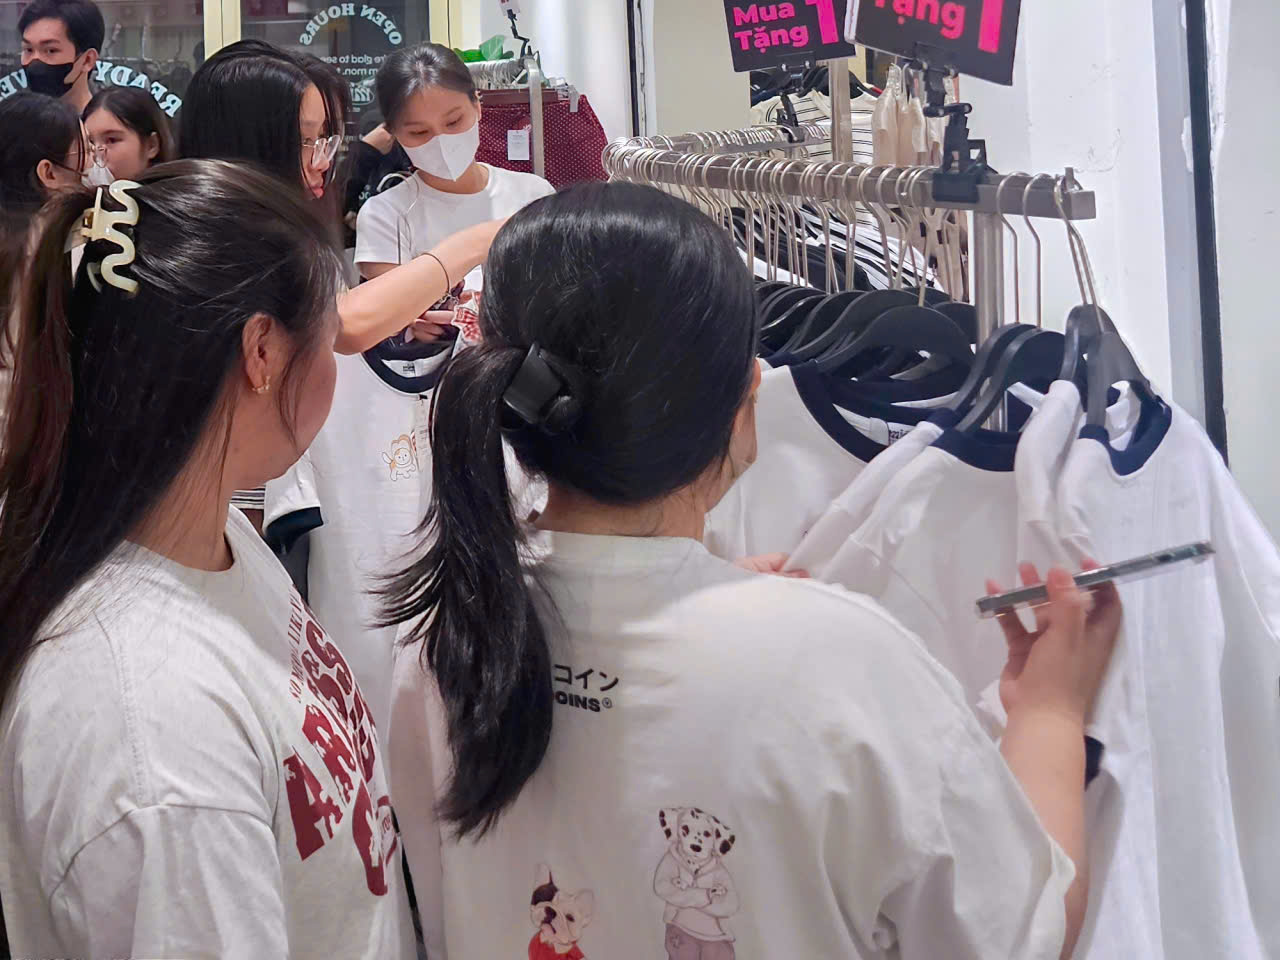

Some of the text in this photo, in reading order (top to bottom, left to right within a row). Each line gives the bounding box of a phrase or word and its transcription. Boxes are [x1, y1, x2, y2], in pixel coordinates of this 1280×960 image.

[734, 0, 796, 26] Mua
[734, 24, 809, 53] Tặng
[554, 664, 619, 692] コイン
